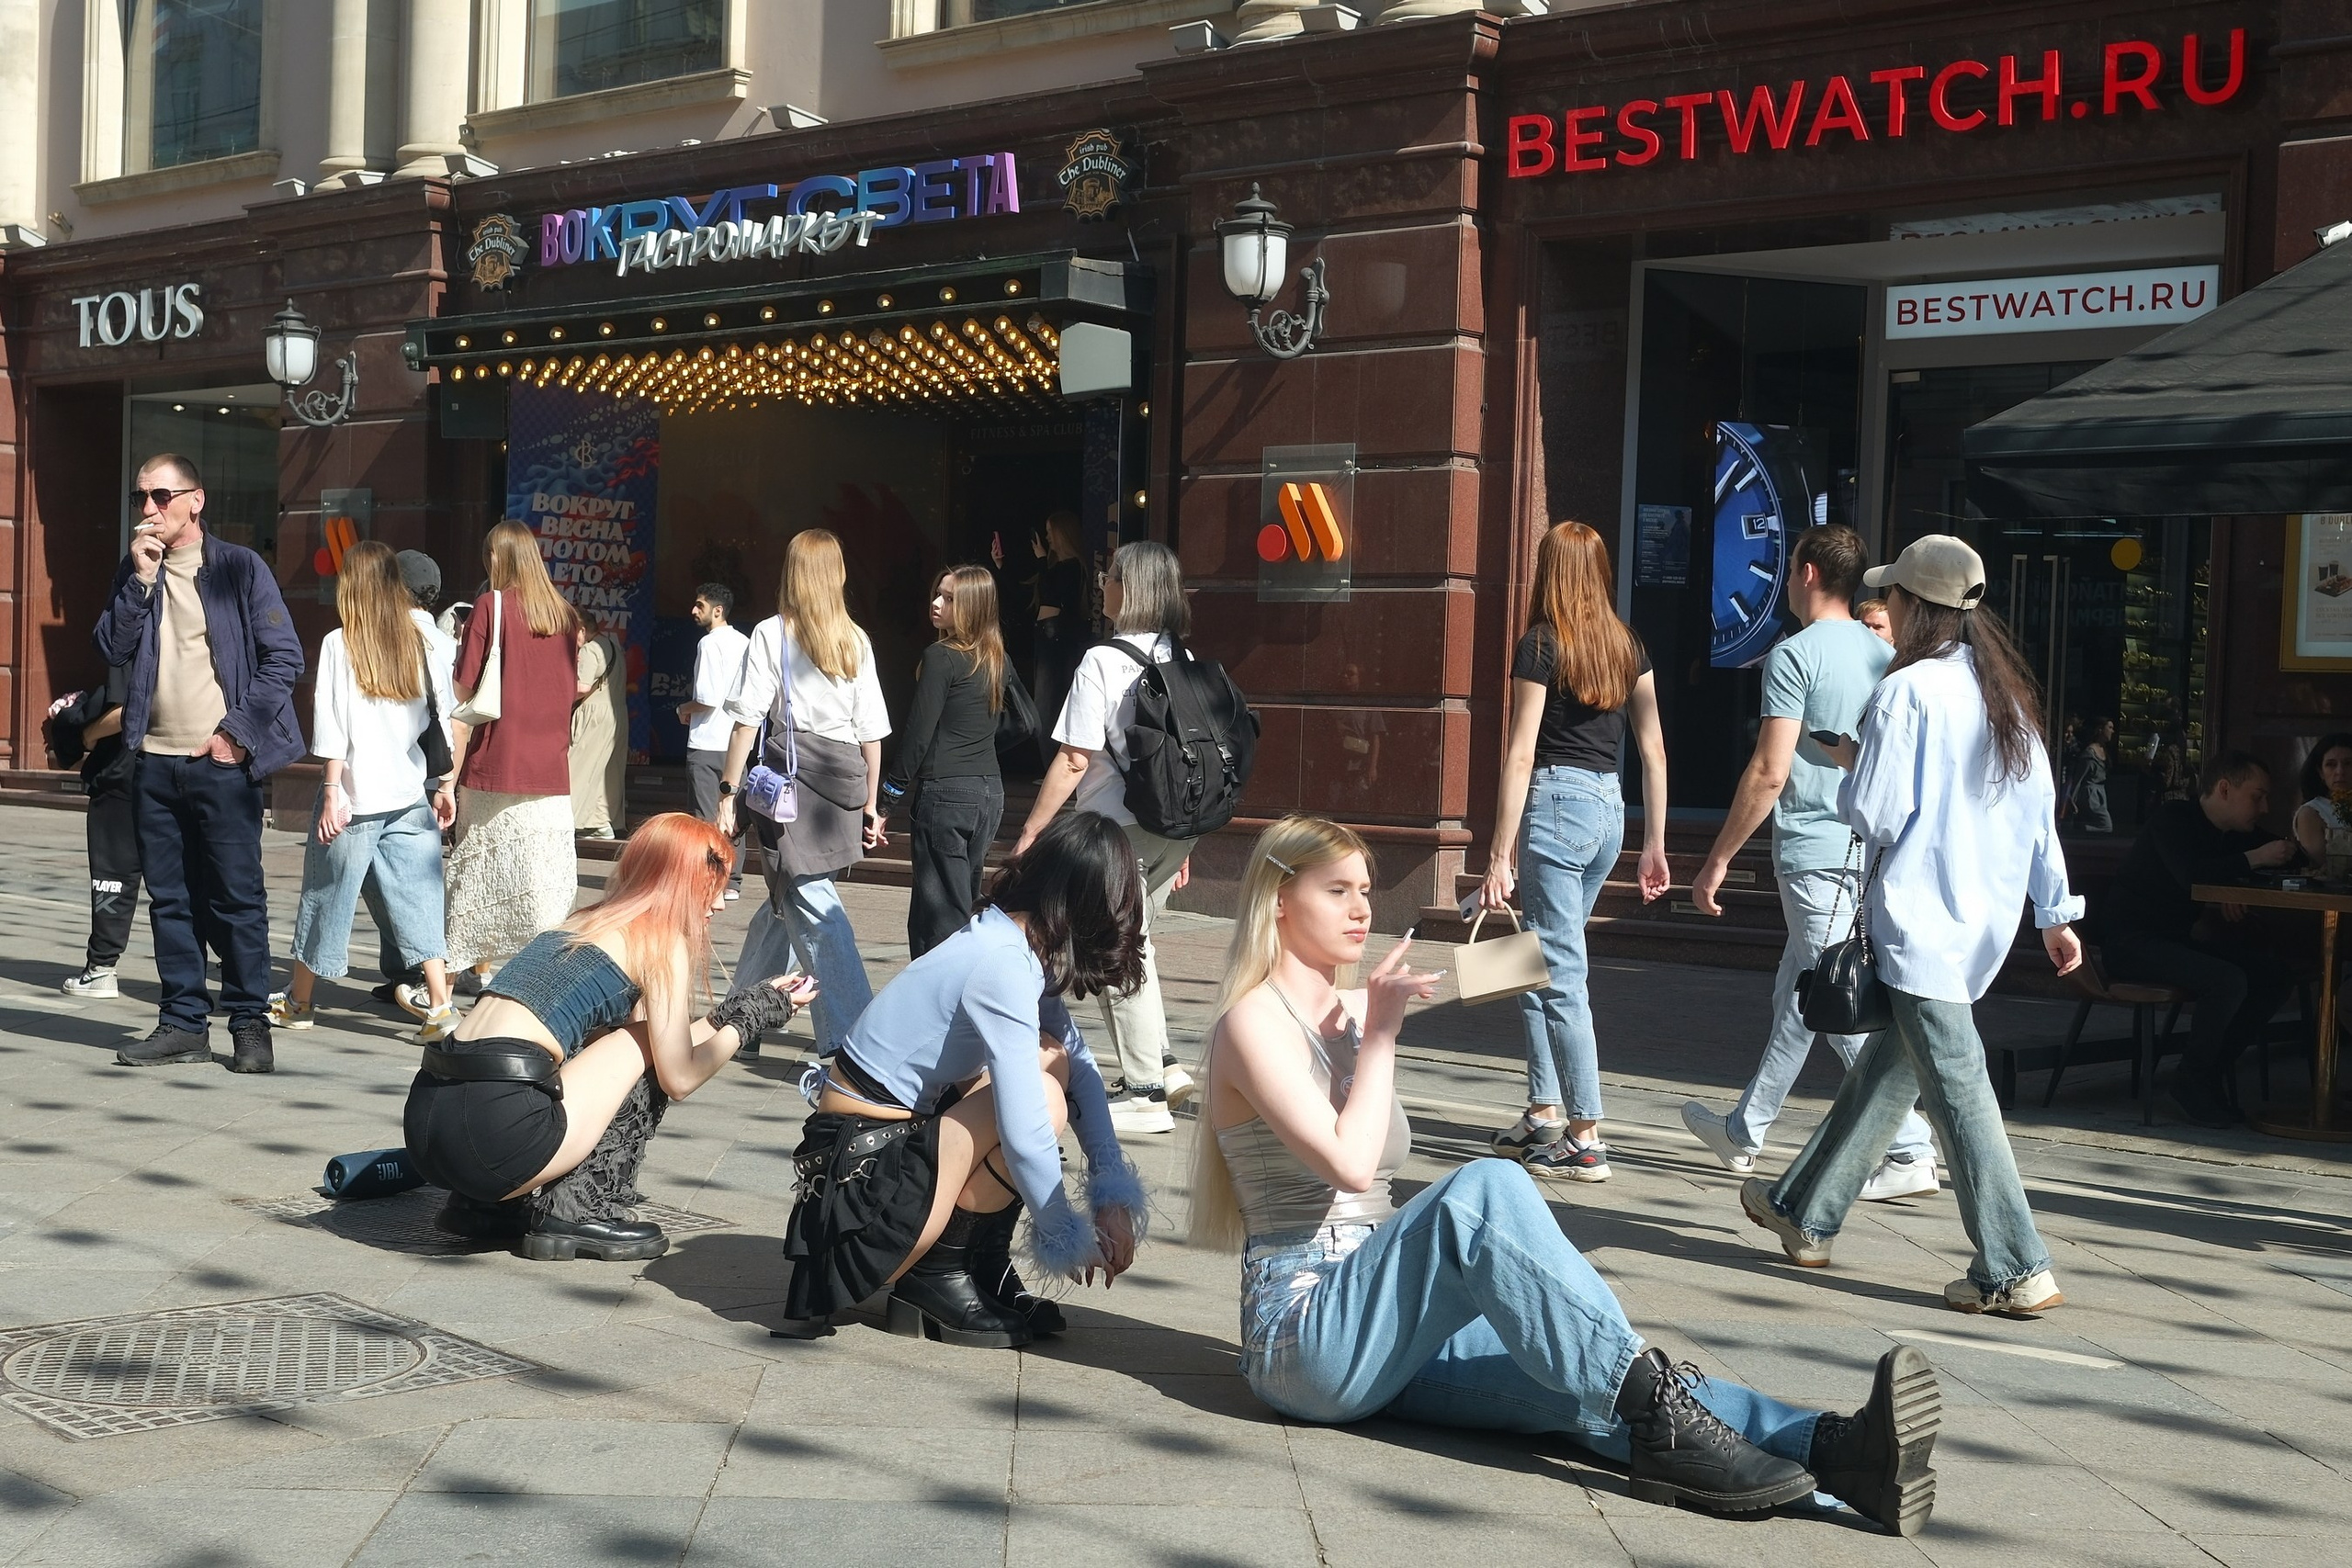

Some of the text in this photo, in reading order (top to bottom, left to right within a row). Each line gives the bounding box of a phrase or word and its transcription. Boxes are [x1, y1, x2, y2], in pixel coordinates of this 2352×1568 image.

[1508, 28, 2245, 178] BESTWATCH.RU
[1079, 142, 1108, 154] irish pub
[1058, 155, 1126, 186] The Dubliner
[786, 152, 1020, 229] СВЕТА
[469, 236, 515, 261] The Dubliner
[616, 210, 886, 277] ГАСТРОМАРКЕТ
[72, 283, 204, 347] TOUS
[1896, 280, 2206, 326] BESTWATCH.RU
[970, 423, 1083, 440] FITNESS & SPA CLUB
[531, 491, 635, 520] ВОКРУГ
[540, 515, 631, 546] ВЕСНА,
[1752, 518, 1766, 530] 12
[537, 536, 631, 564] ПОТОМ
[92, 878, 123, 893] PLAYER
[377, 1161, 403, 1181] JBL
